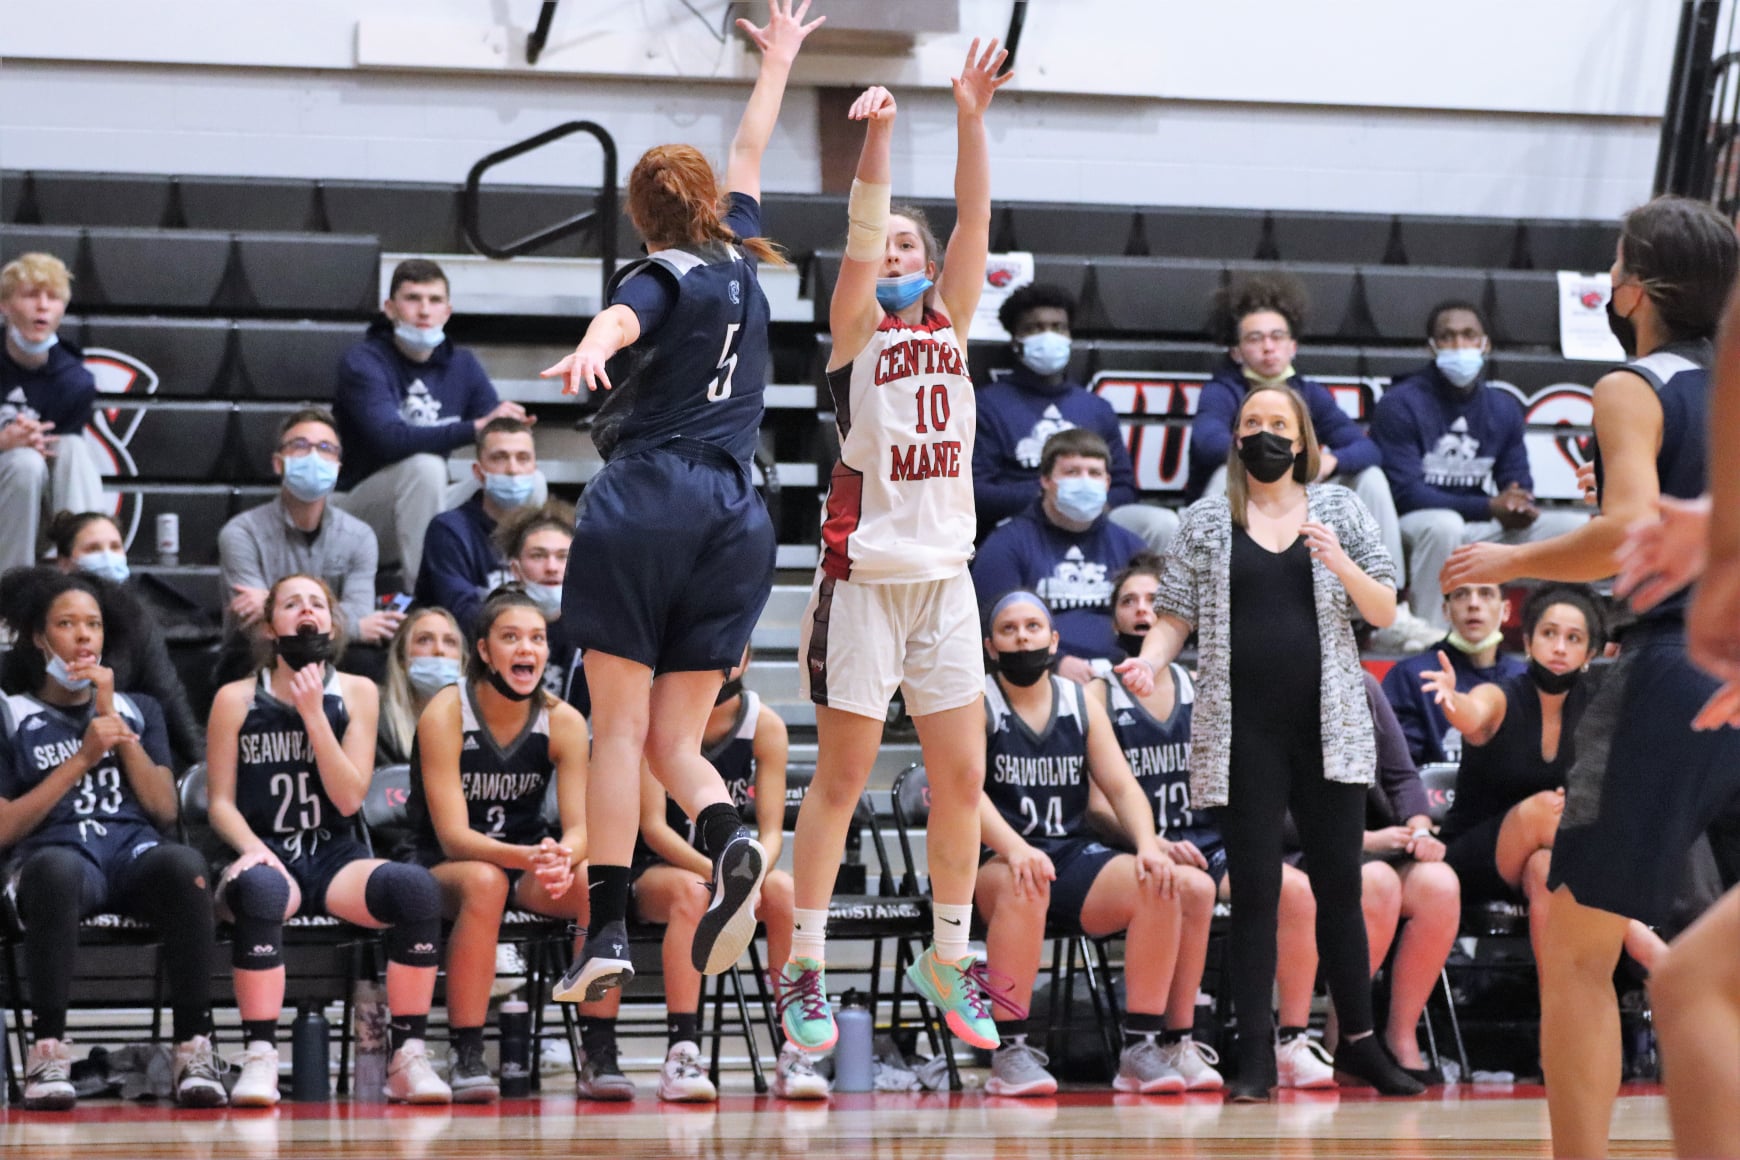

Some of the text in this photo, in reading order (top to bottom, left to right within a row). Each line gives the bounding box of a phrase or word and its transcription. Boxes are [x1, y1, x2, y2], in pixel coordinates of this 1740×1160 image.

[706, 323, 741, 402] 5
[875, 338, 973, 386] CENTRA
[915, 384, 950, 433] 10
[890, 441, 961, 481] MANE
[73, 767, 123, 814] 33
[270, 771, 321, 833] 25
[1154, 782, 1193, 828] 13
[485, 805, 506, 838] 2
[1021, 796, 1068, 836] 24
